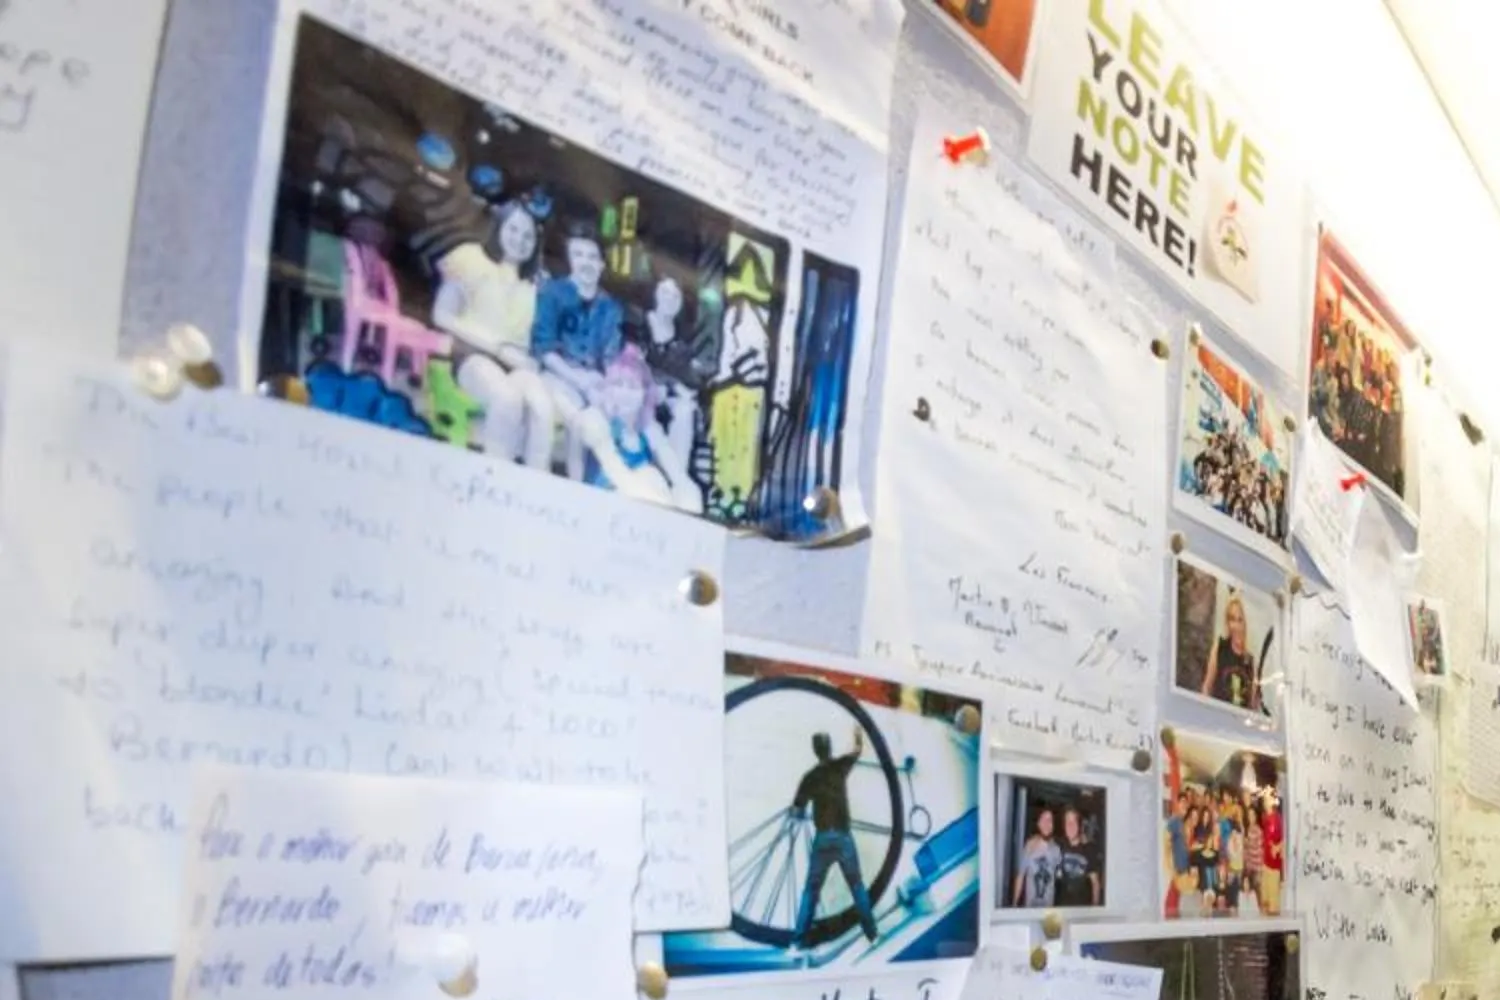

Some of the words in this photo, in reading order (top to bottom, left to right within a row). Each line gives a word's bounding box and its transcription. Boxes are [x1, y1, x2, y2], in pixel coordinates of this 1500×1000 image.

[1076, 75, 1193, 221] NOTE
[1087, 32, 1198, 181] YOUR
[1088, 0, 1266, 205] LEAVE
[1070, 133, 1198, 278] HERE!
